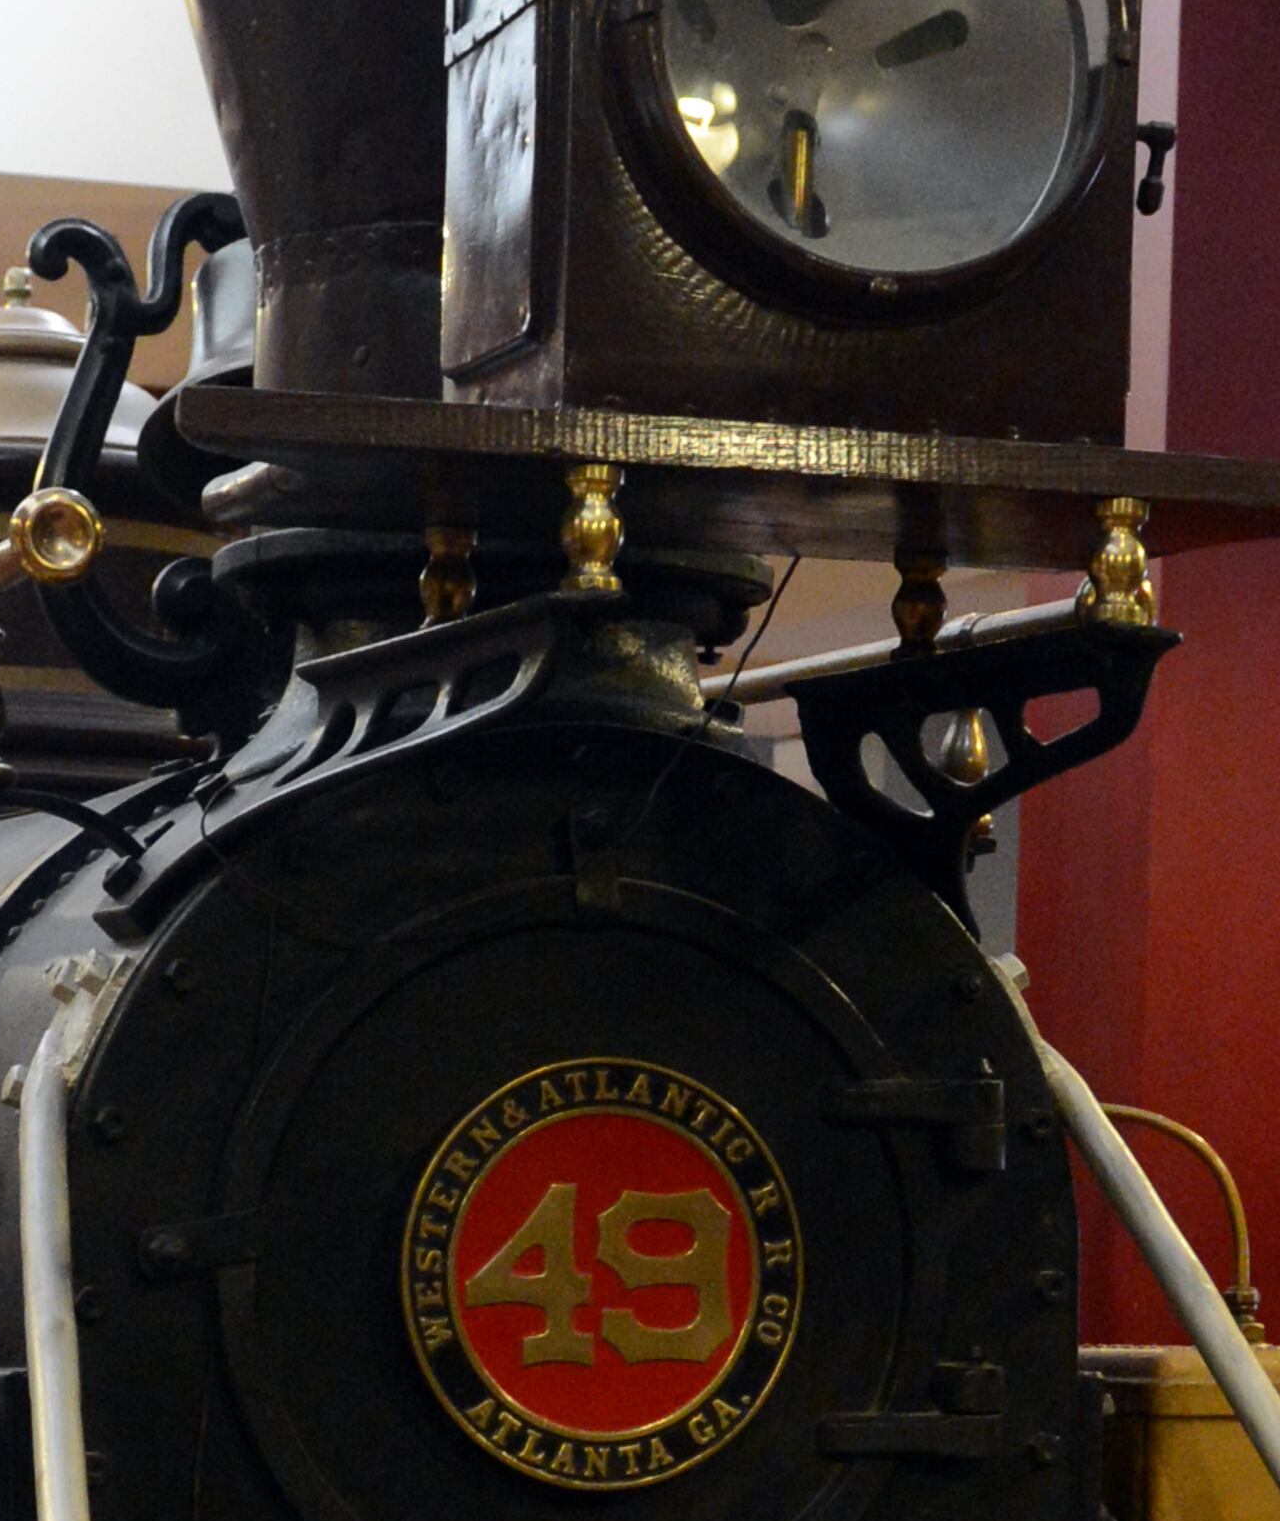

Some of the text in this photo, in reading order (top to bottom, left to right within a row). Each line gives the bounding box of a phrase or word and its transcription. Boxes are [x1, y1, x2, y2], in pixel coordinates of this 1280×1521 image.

[415, 1117, 506, 1349] WESTERN
[503, 1099, 529, 1128] &
[539, 1069, 756, 1165] ATLANTIC
[464, 1182, 734, 1368] 49
[466, 1393, 752, 1477] ATLANTA GA.
